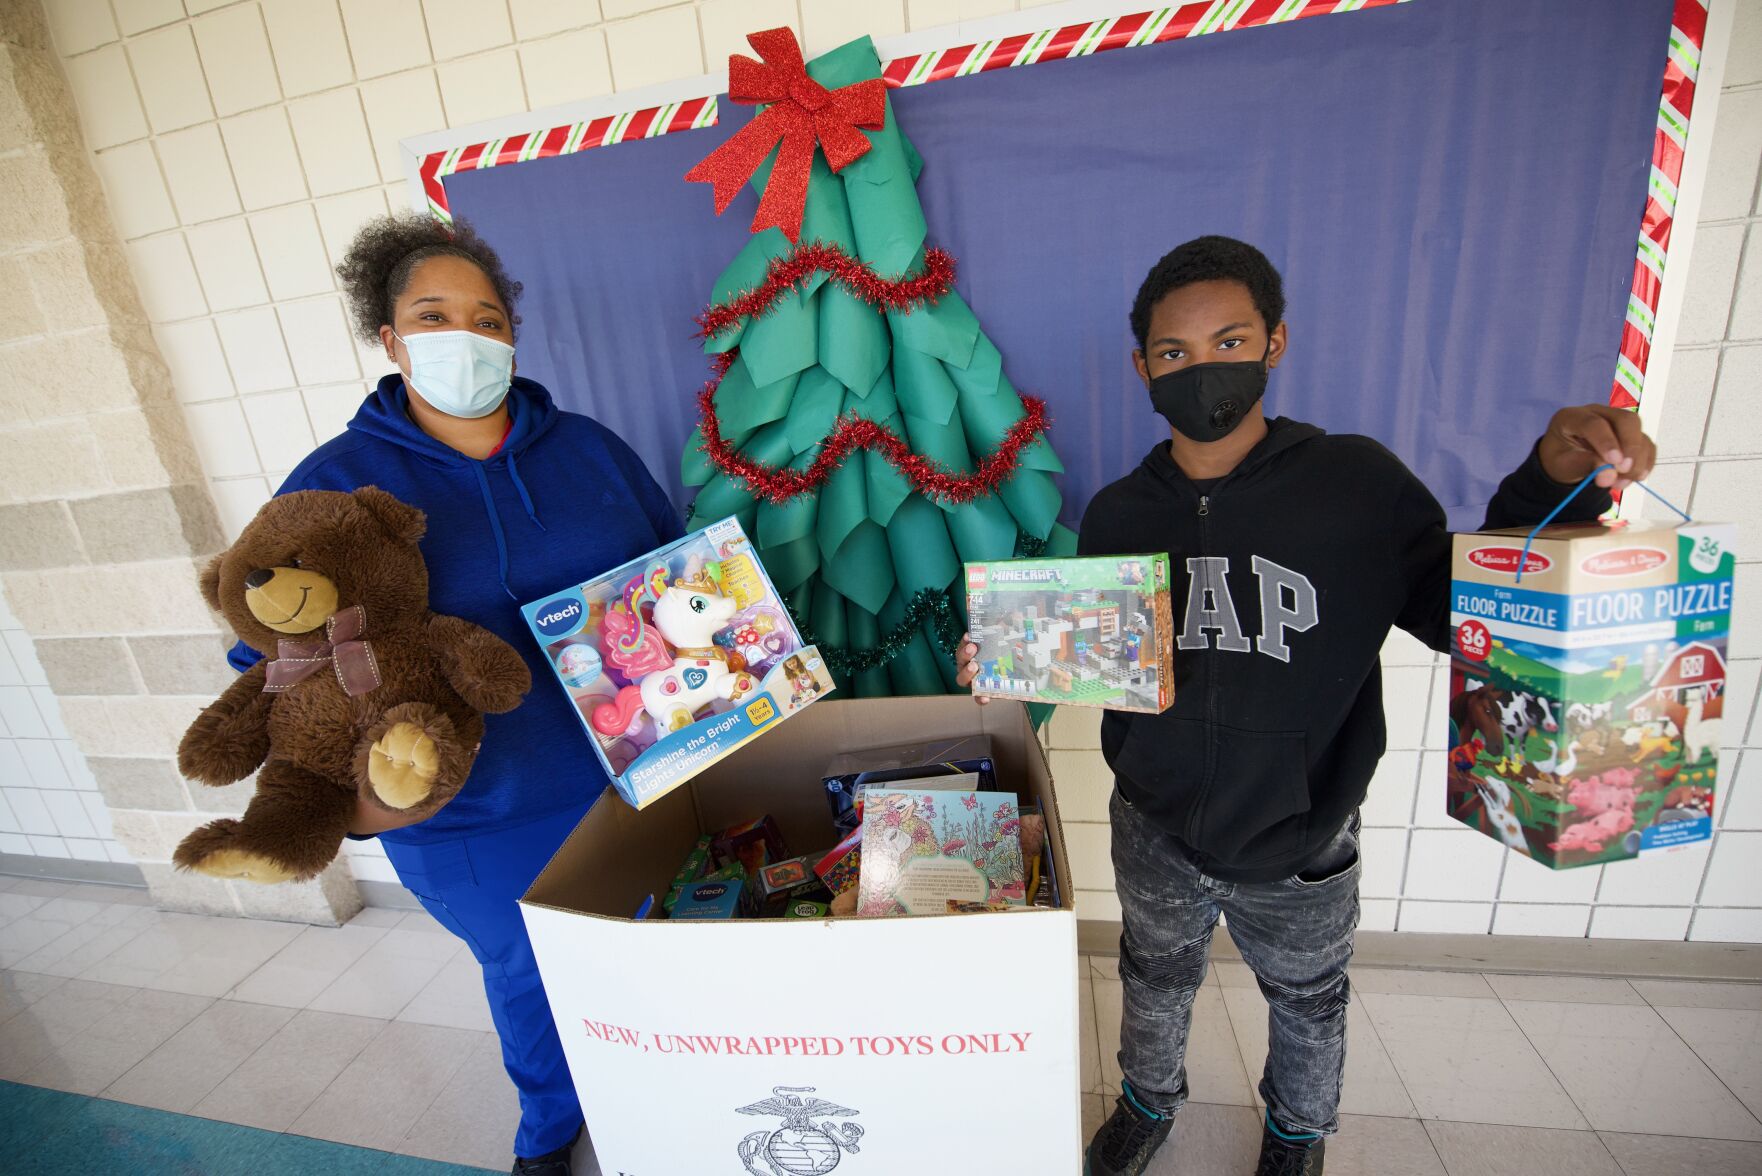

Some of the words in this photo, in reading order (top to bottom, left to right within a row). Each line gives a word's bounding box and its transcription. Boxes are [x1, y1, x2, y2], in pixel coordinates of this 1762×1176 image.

[1699, 536, 1720, 557] 36
[991, 568, 1063, 584] MINECRAFT
[536, 604, 580, 627] vtech
[1176, 554, 1319, 663] AP
[1457, 595, 1497, 617] FLOOR
[1501, 602, 1558, 628] PUZZLE
[1572, 592, 1644, 627] FLOOR
[1654, 582, 1731, 618] PUZZLE
[1461, 625, 1486, 648] 36
[632, 747, 687, 784] Starshine
[687, 735, 706, 751] the
[706, 714, 740, 739] Bright
[636, 768, 676, 794] Lights
[676, 741, 720, 771] Unicorn
[582, 1018, 649, 1052] NEW,
[653, 1033, 844, 1056] UNWRAPPED
[850, 1035, 934, 1056] TOYS
[941, 1031, 1033, 1055] ONLY
